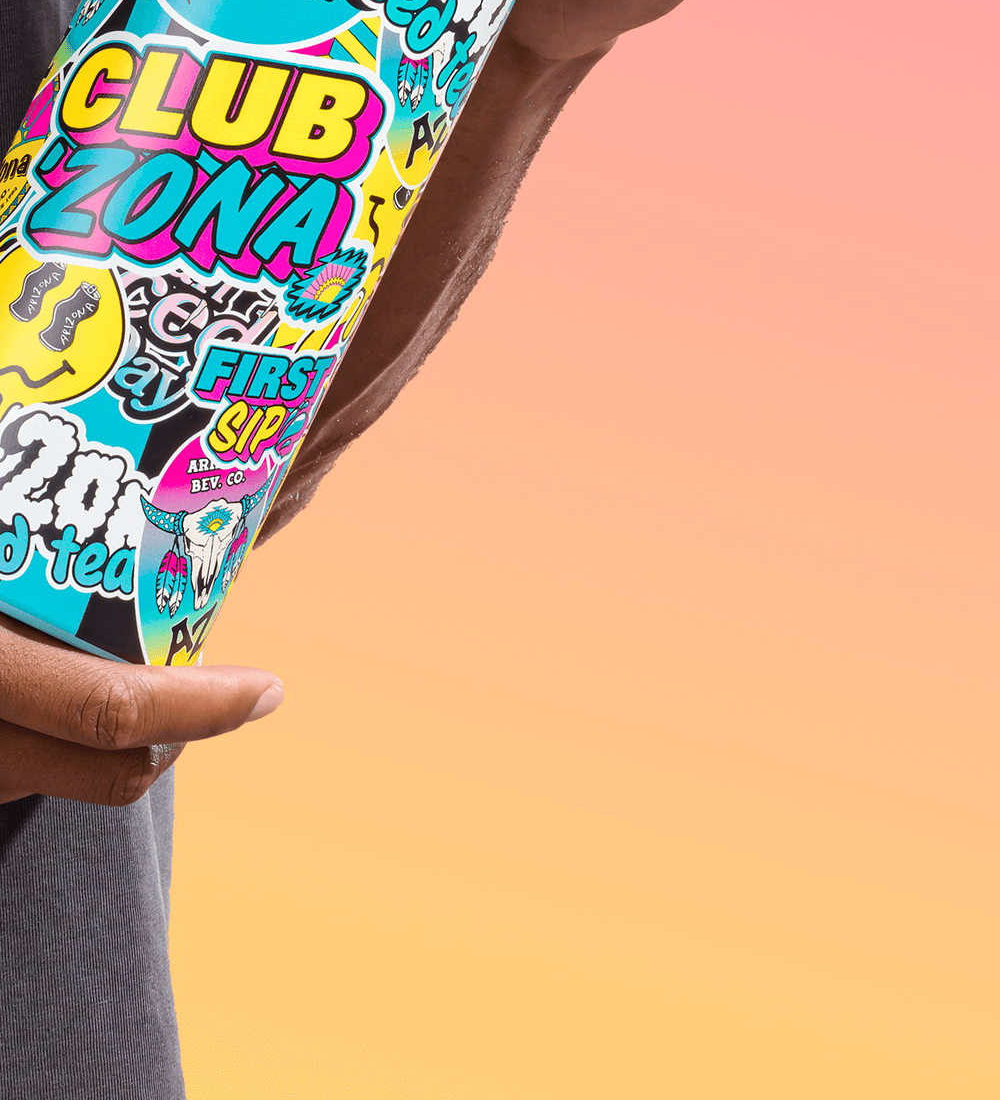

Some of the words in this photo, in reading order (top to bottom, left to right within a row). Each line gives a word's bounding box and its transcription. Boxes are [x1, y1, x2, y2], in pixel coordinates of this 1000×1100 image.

[61, 46, 368, 162] CLUB
[26, 142, 341, 267] 'ZONA
[27, 271, 62, 315] ARIZONA
[60, 302, 96, 346] ARIZONA
[195, 345, 336, 401] FIRST
[190, 474, 222, 494] BEV.
[226, 469, 247, 487] CO.
[50, 524, 137, 594] tea
